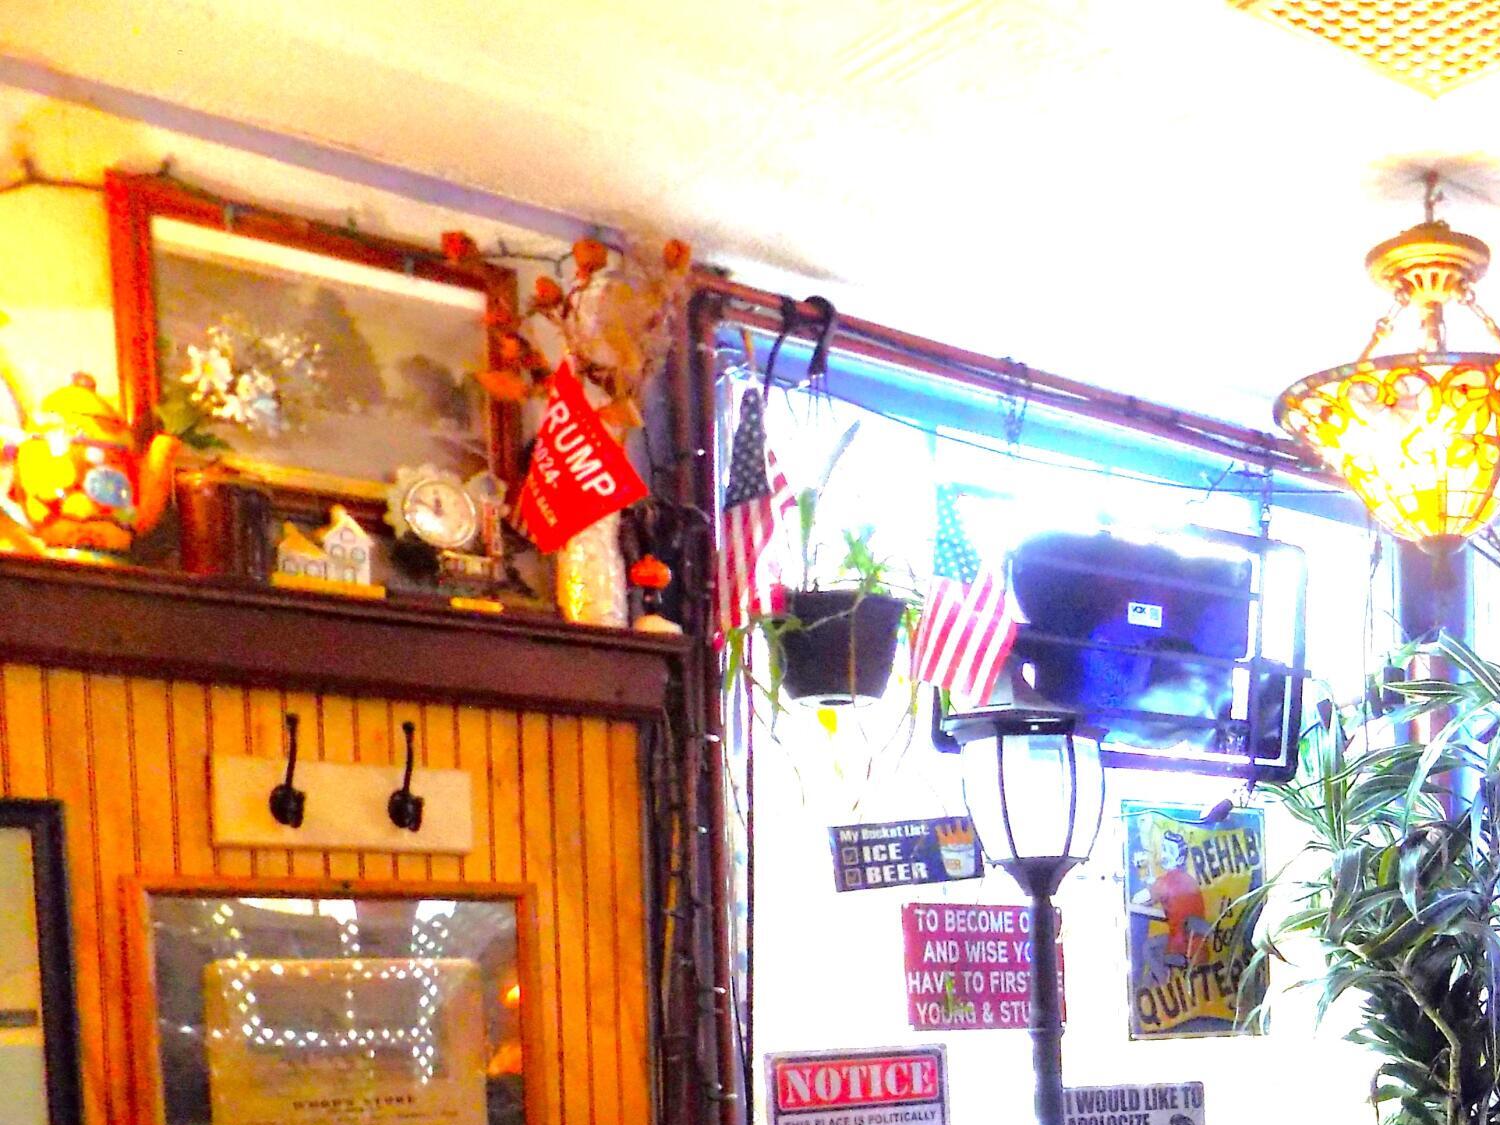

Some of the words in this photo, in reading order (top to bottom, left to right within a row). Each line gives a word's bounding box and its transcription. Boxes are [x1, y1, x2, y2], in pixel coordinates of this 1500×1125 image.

[839, 829, 858, 843] My
[862, 843, 903, 863] ICE
[1189, 827, 1262, 886] REHAB
[865, 862, 929, 884] BEER
[915, 910, 938, 932] TO
[945, 910, 1014, 933] BECOME
[924, 941, 960, 963] AND
[965, 941, 1009, 963] WISE
[908, 971, 956, 994] HAVE
[963, 972, 984, 993] TO
[990, 972, 1032, 993] FIRS
[983, 1002, 993, 1023] &
[785, 1060, 934, 1104] NOTICE
[1065, 1092, 1072, 1115] I
[1075, 1088, 1140, 1114] WOULD
[1144, 1086, 1179, 1111] LIKE
[1183, 1086, 1202, 1109] TO
[854, 1115, 865, 1125] IS
[868, 1110, 937, 1125] POLITICALLY
